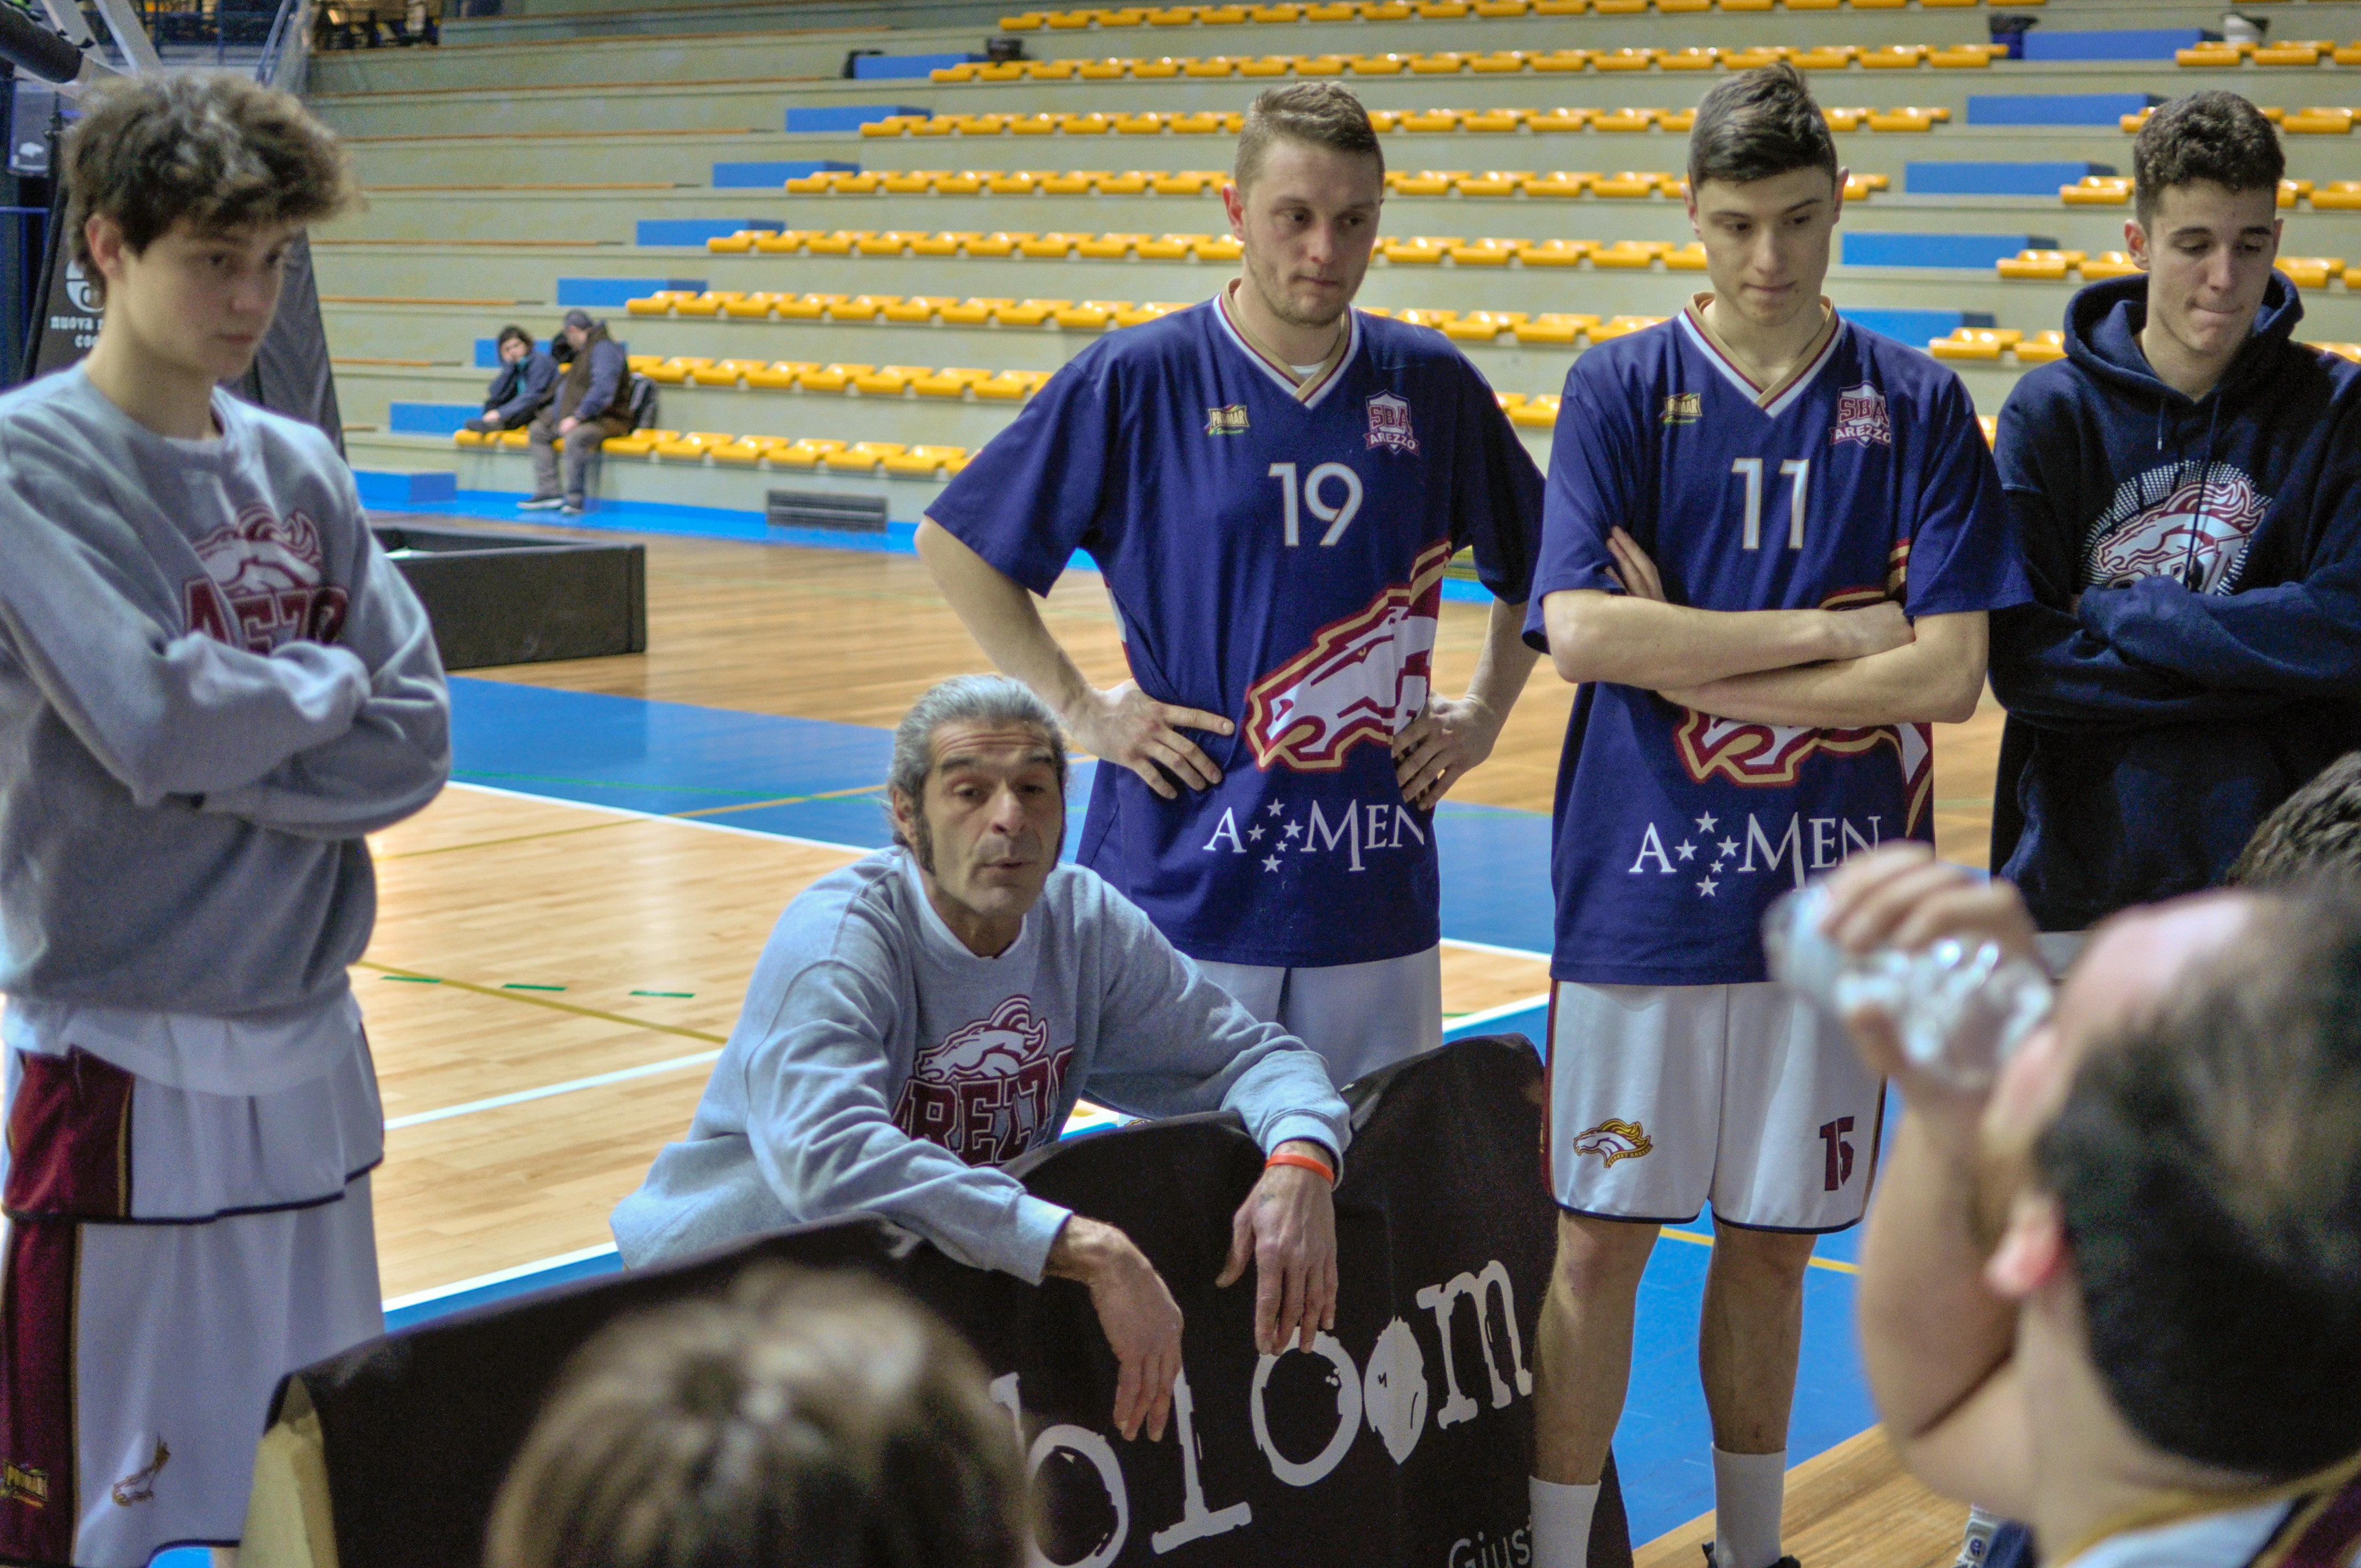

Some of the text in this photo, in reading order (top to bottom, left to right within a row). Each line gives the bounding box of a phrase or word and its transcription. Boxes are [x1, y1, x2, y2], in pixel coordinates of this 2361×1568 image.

[1369, 405, 1413, 438] SBA
[1840, 397, 1890, 428] SBA
[1370, 432, 1416, 449] AREZZO
[1835, 424, 1891, 443] AREZZO
[1268, 462, 1363, 546] 19
[1731, 458, 1809, 550] 11
